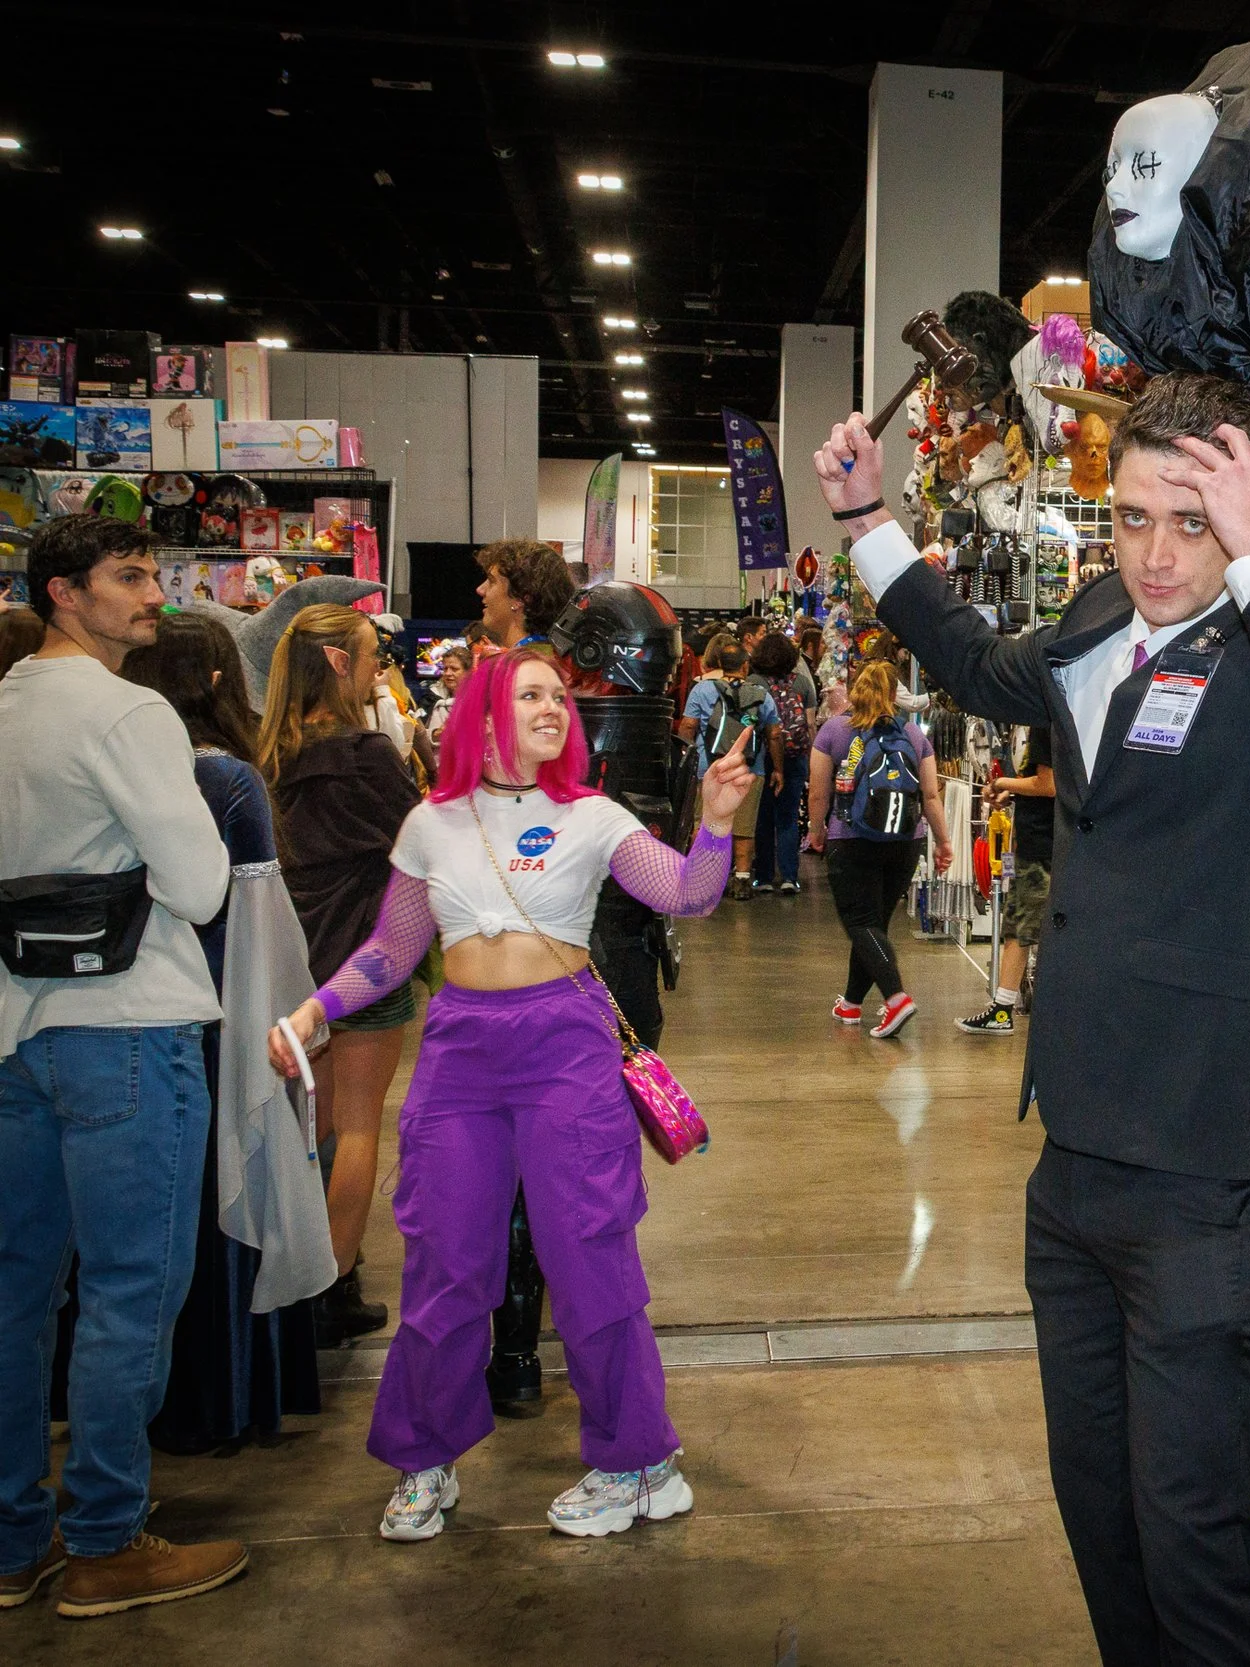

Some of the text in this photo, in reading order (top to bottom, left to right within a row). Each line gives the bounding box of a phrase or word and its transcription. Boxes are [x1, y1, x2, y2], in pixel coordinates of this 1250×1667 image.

[928, 89, 955, 100] E-42
[729, 419, 754, 565] CRYSTALS
[613, 644, 642, 657] N7
[1134, 731, 1177, 743] ALL DAYS
[519, 837, 553, 847] NASA
[509, 858, 545, 872] USA
